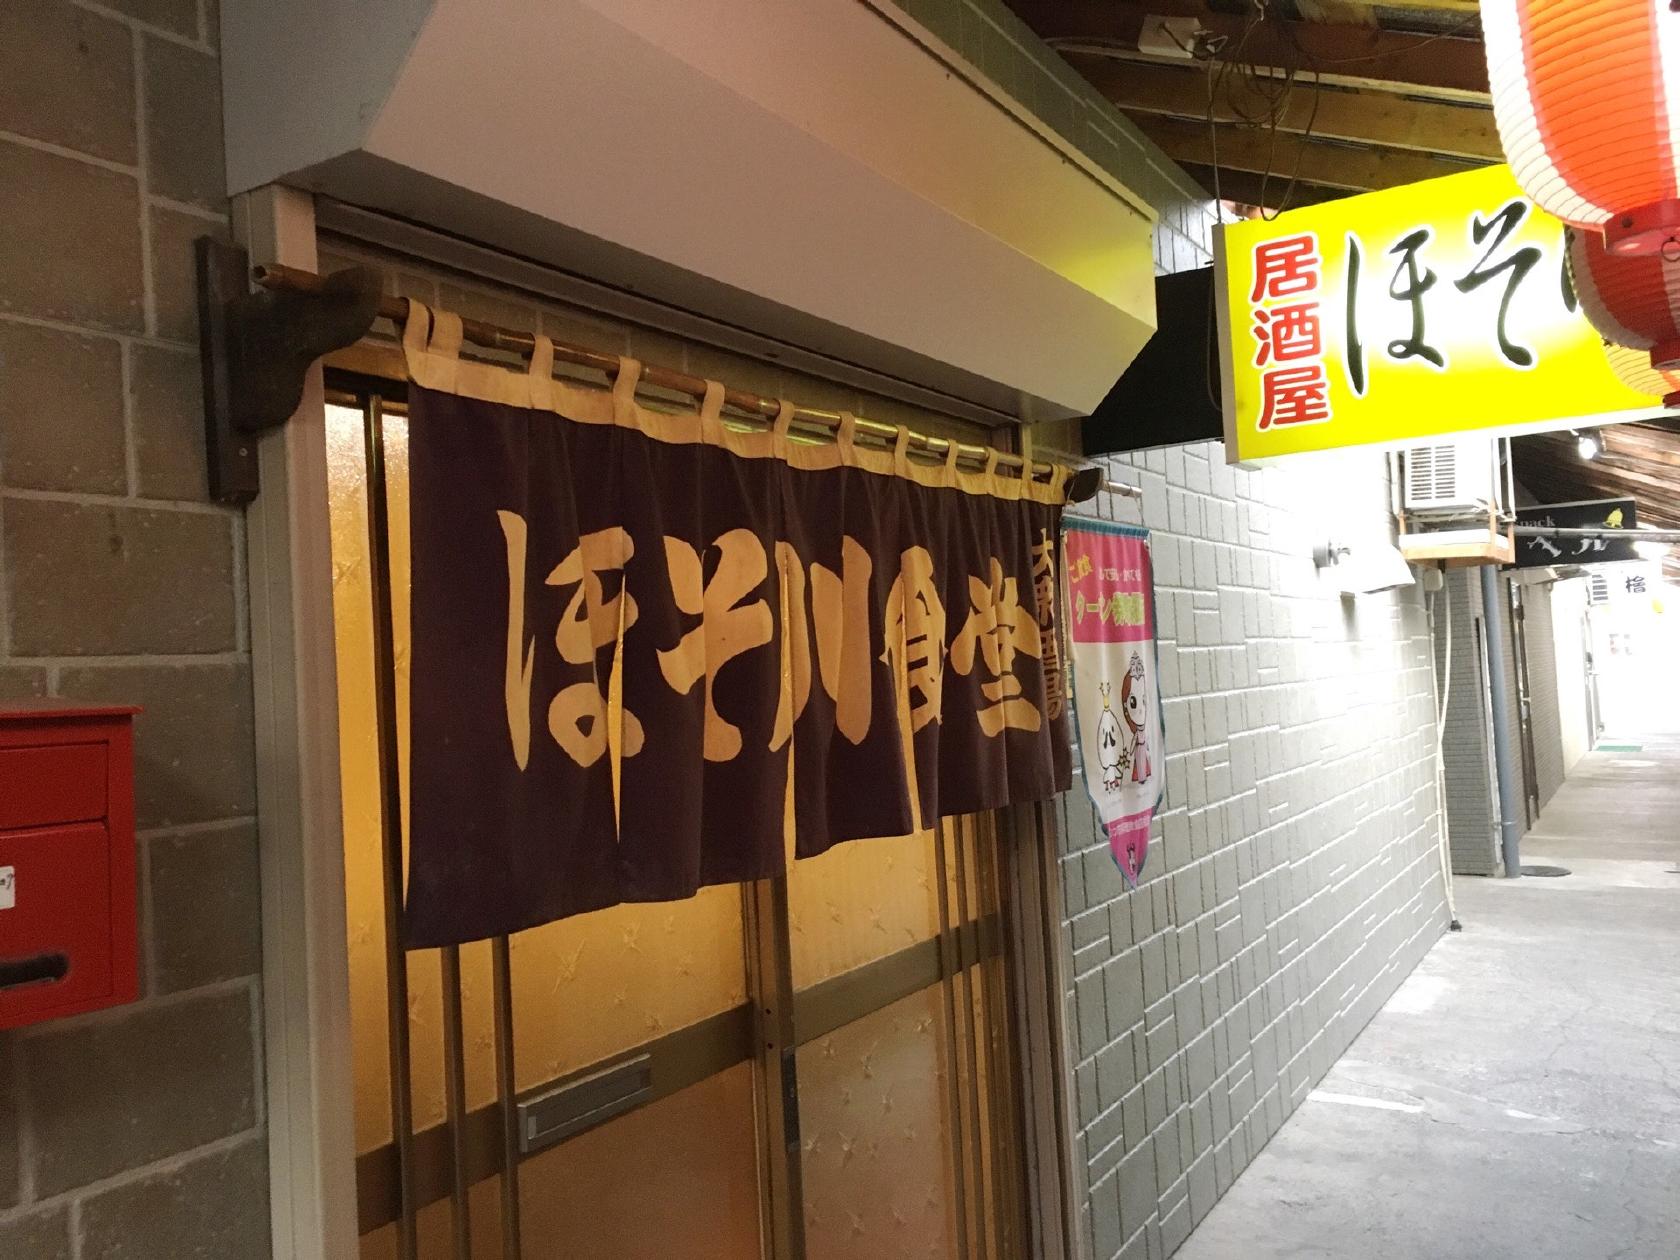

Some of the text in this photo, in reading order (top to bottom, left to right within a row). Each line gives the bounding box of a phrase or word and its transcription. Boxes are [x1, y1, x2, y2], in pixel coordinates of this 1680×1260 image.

[1251, 235, 1330, 431] 居酒屋
[1346, 201, 1580, 397] ほそ
[496, 510, 1042, 772] ほそ川食堂
